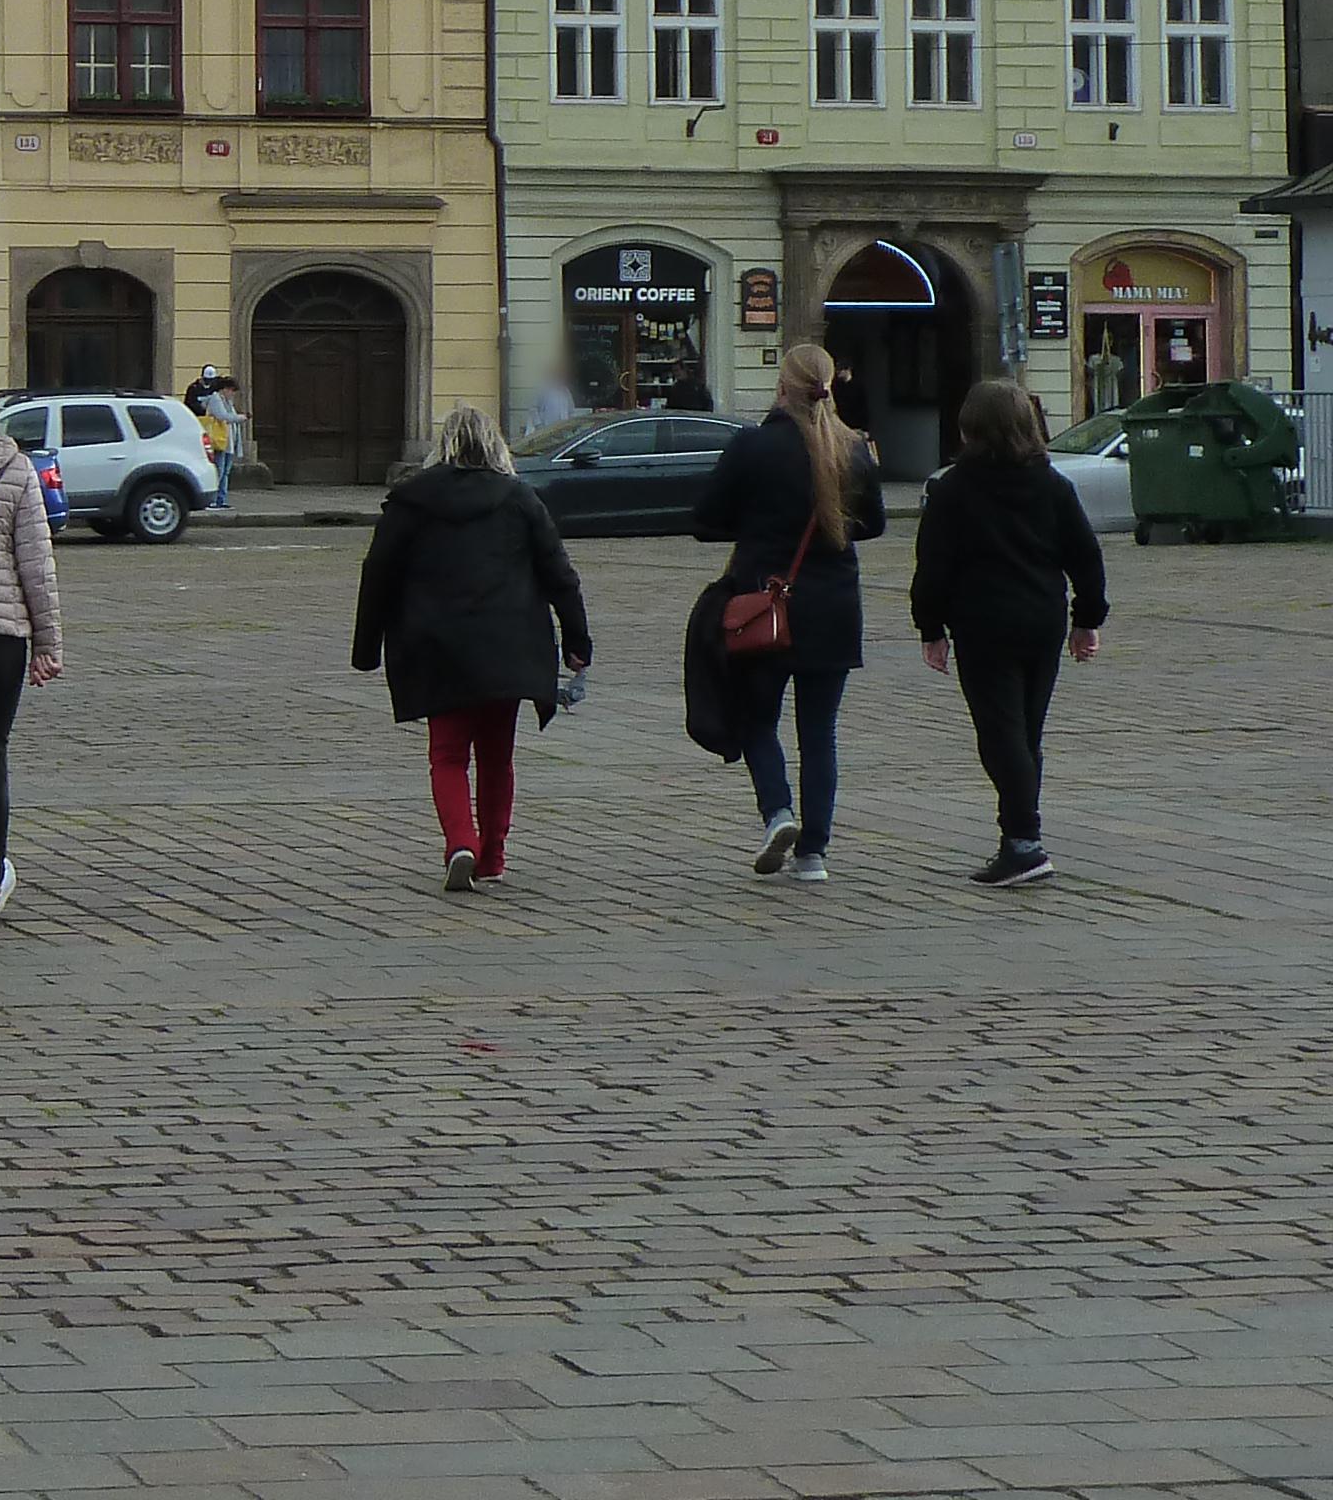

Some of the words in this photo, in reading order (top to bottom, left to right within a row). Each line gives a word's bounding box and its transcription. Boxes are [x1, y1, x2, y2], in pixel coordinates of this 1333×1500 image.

[575, 287, 632, 301] ORIENT
[636, 287, 696, 301] COFFEE
[1112, 286, 1152, 299] MAMA
